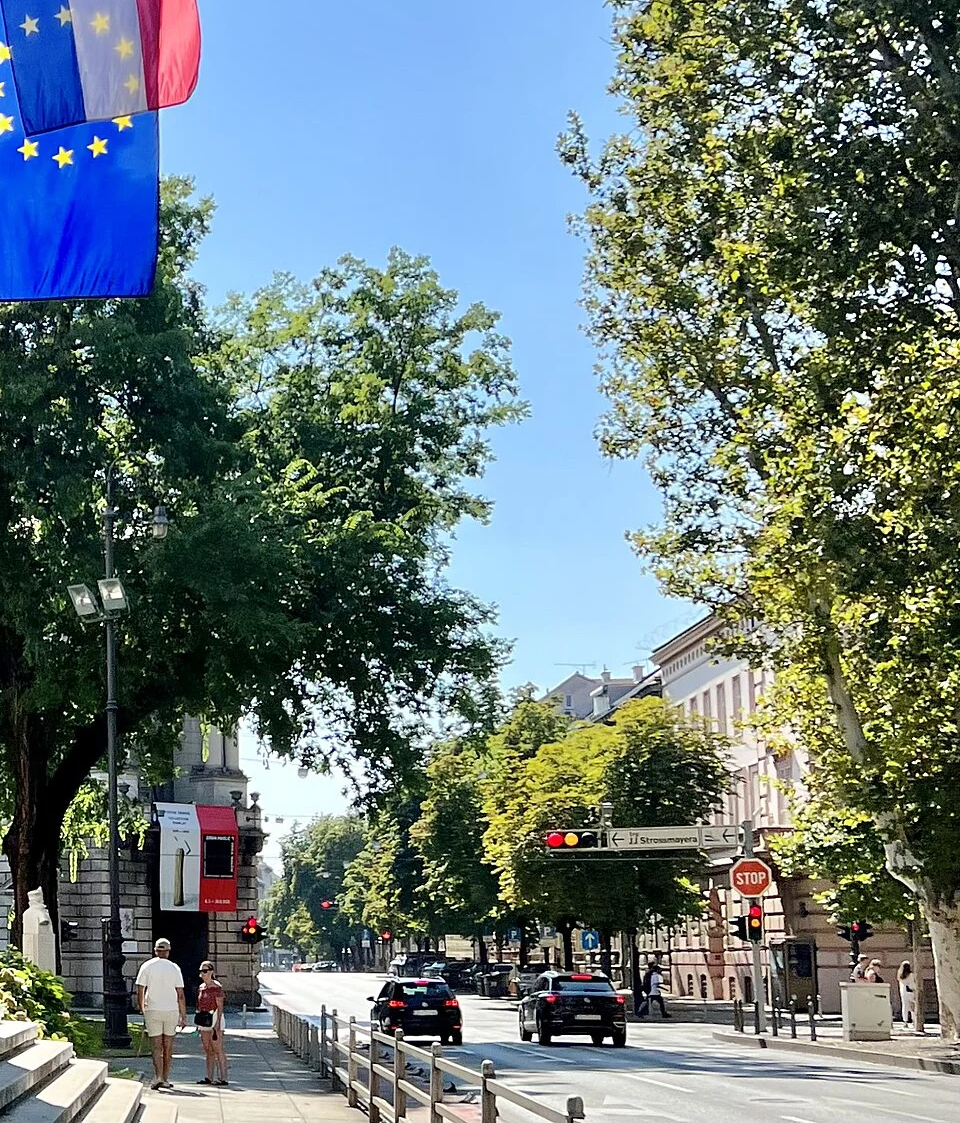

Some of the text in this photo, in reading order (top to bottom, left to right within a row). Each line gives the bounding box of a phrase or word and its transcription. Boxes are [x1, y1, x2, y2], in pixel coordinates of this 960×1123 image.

[640, 836, 698, 845] Strossmayera
[736, 872, 766, 885] STOP
[511, 930, 518, 939] P
[543, 926, 551, 936] P
